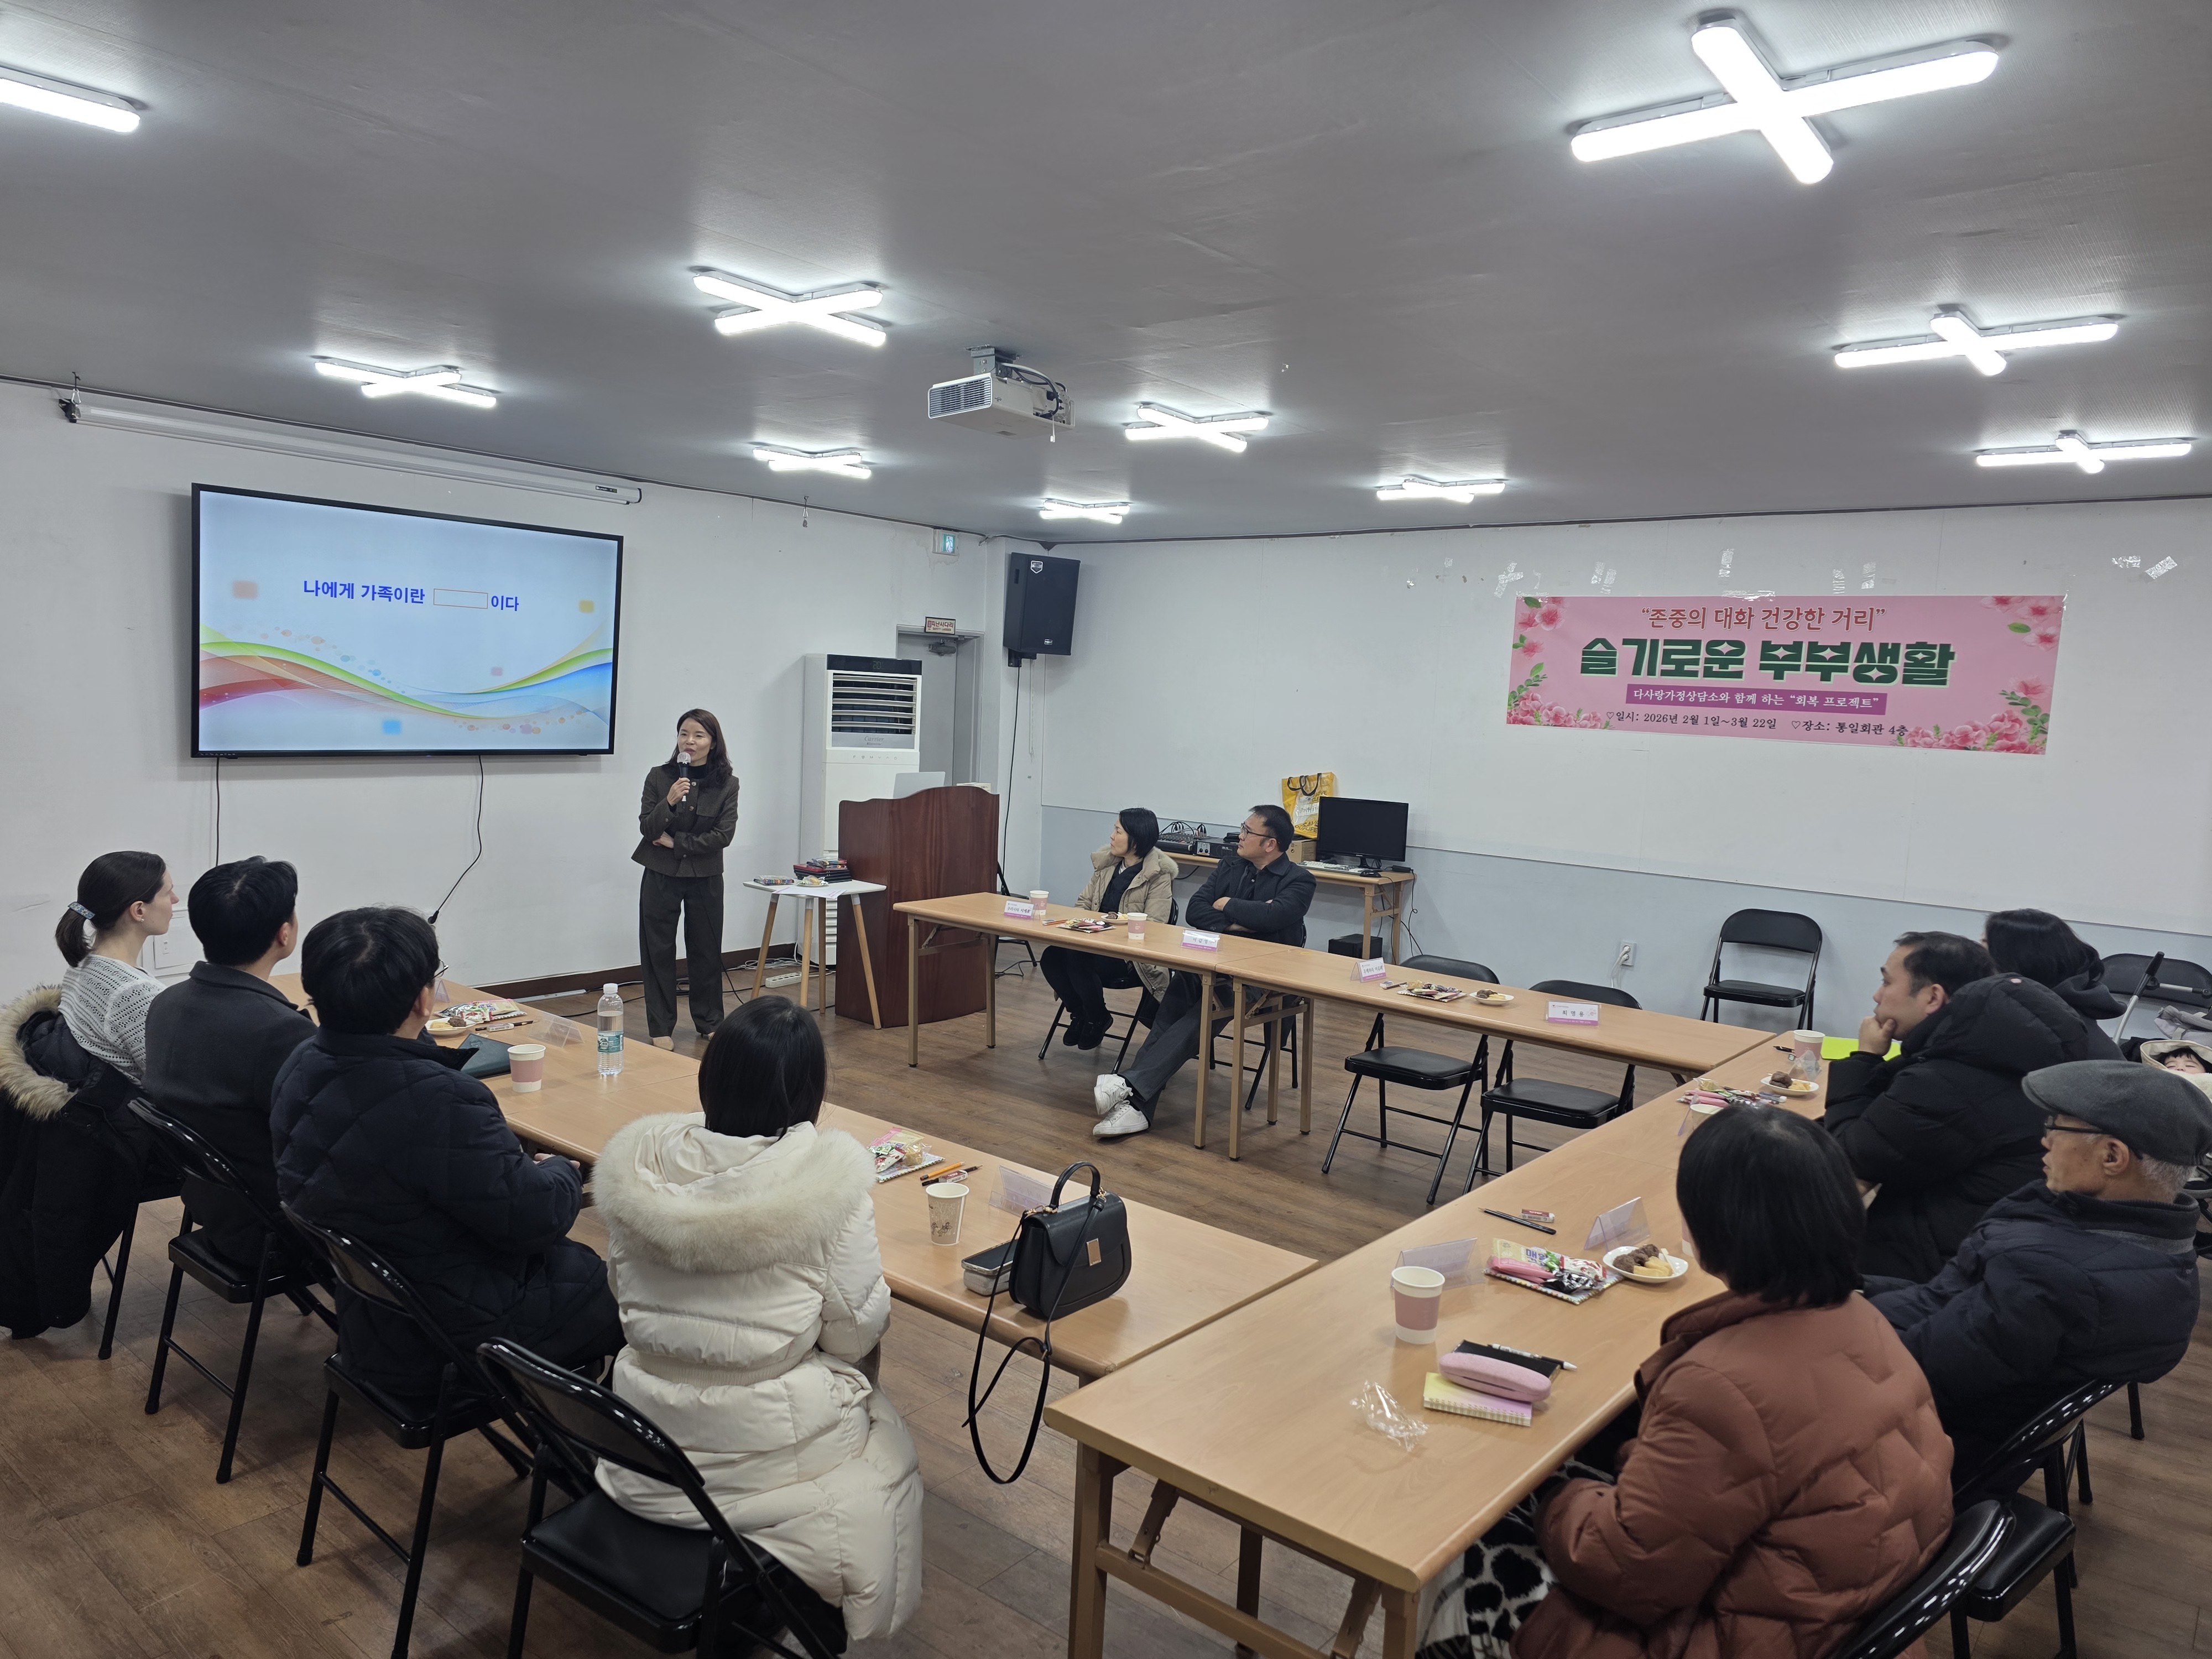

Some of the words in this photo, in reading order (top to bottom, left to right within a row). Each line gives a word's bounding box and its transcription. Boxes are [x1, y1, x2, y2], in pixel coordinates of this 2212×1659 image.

[304, 580, 354, 599] 나에게
[361, 584, 425, 604] 가족이란
[491, 596, 519, 612] 이다
[1642, 607, 1707, 629] “존중의
[1714, 607, 1755, 630] 대화
[1761, 607, 1825, 631] 건강한
[1832, 607, 1886, 632] 거리”
[1580, 638, 1747, 680] 슬기로운
[1759, 640, 1956, 687] 부부생활
[1634, 688, 1730, 704] 다사랑가정상담소와
[1735, 692, 1757, 705] 함께
[1761, 693, 1785, 706] 하는
[1644, 713, 1678, 724] 2026년
[1683, 714, 1699, 726] 2월
[1752, 717, 1776, 729] 22일
[1835, 722, 1885, 735] 통일회관
[1889, 724, 1908, 737] 4층
